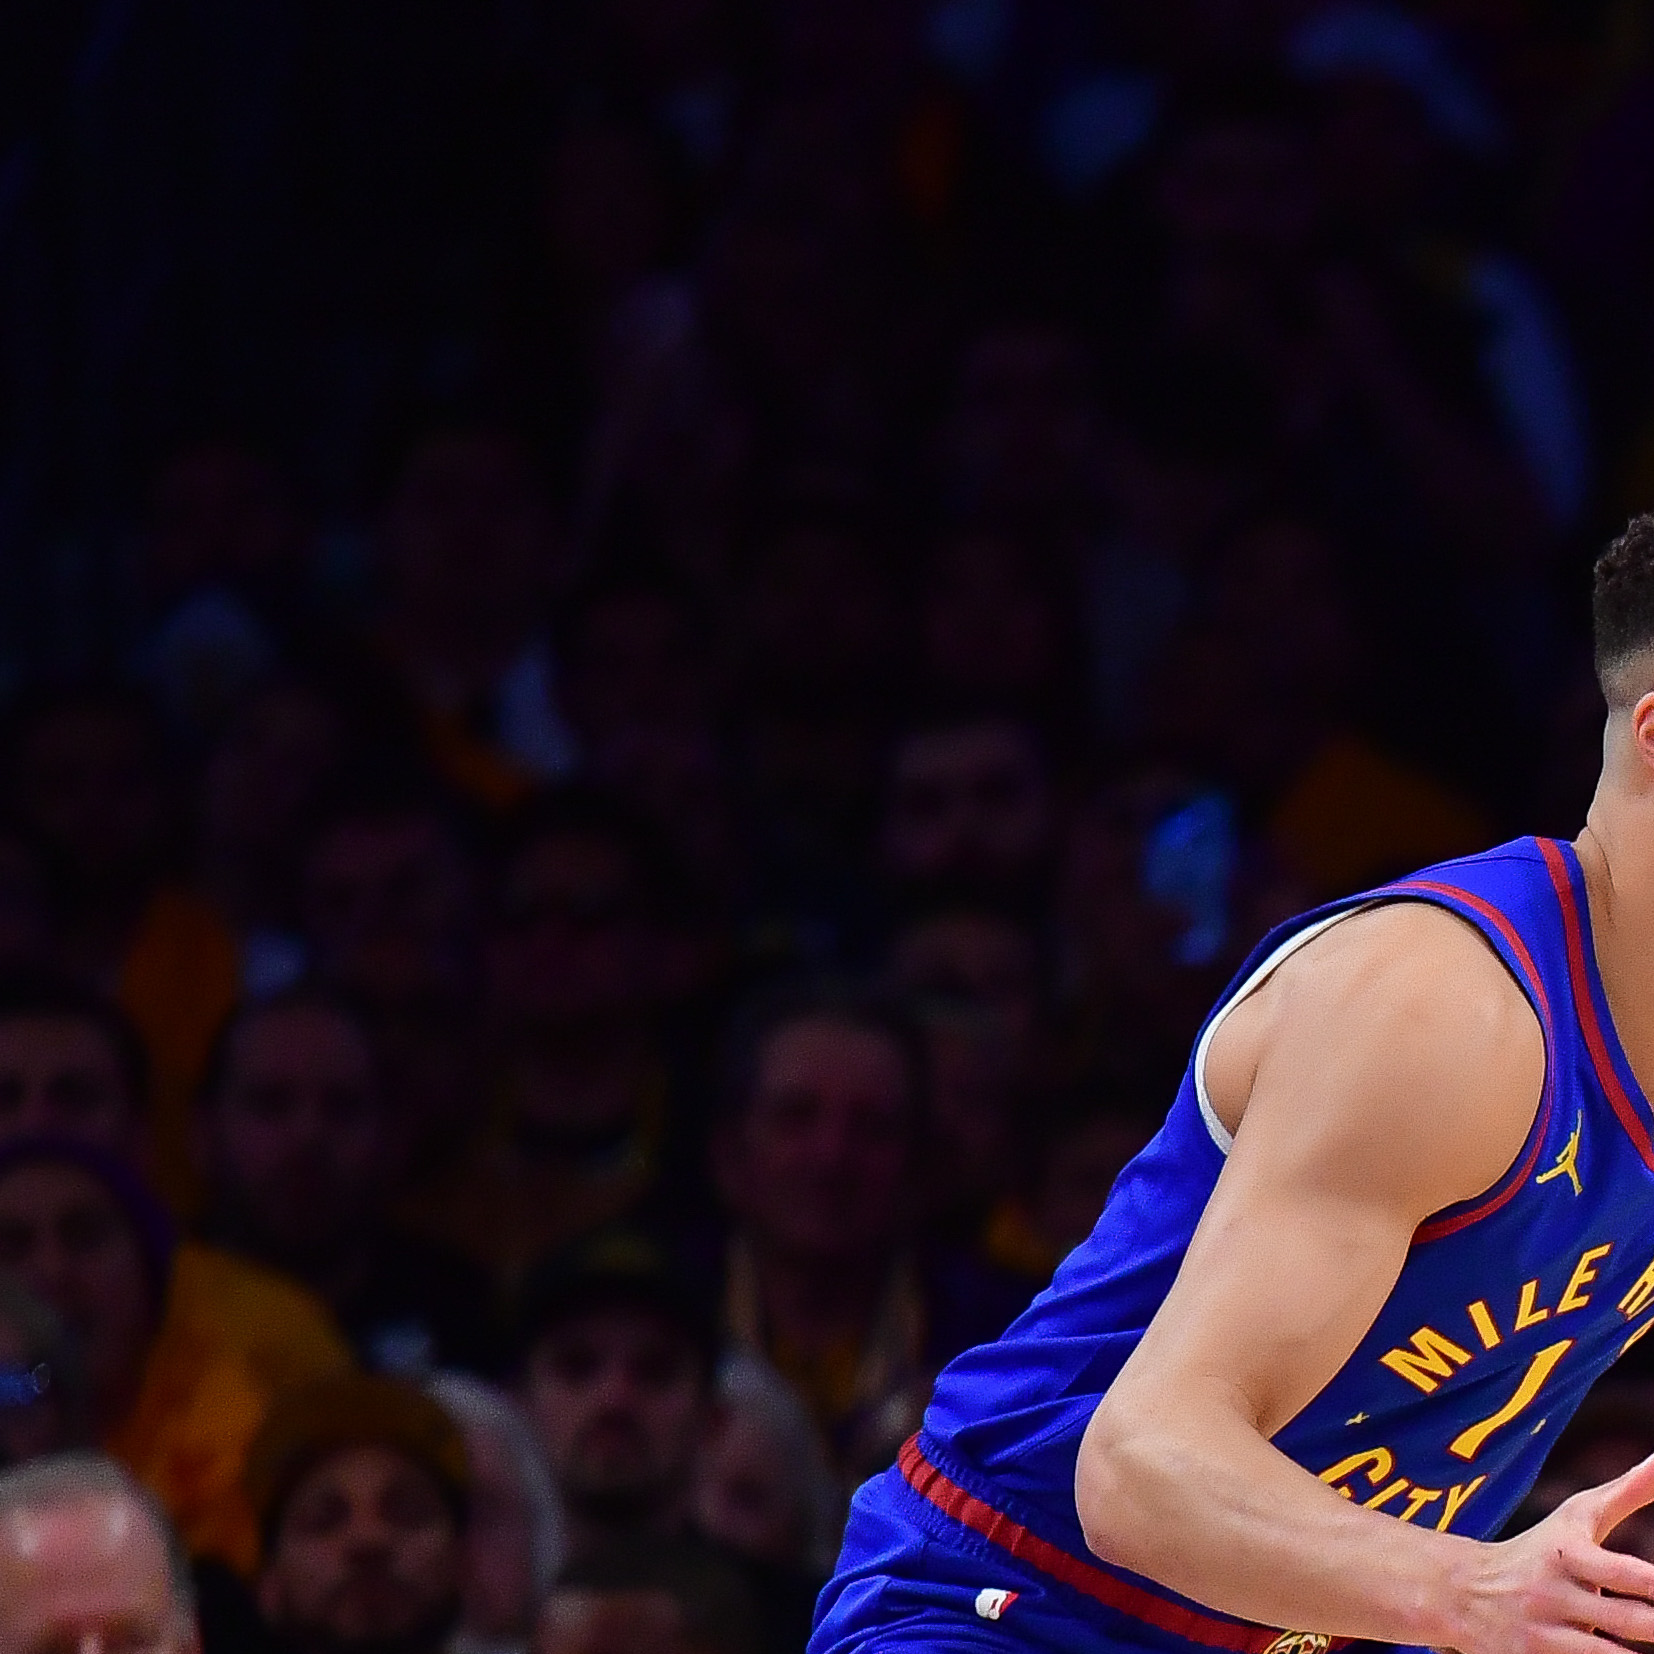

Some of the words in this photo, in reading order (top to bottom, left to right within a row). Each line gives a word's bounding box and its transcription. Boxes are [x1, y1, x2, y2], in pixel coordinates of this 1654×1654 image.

[1378, 1241, 1614, 1394] MILE
[1447, 1337, 1576, 1461] 1
[1317, 1446, 1490, 1533] CITY
